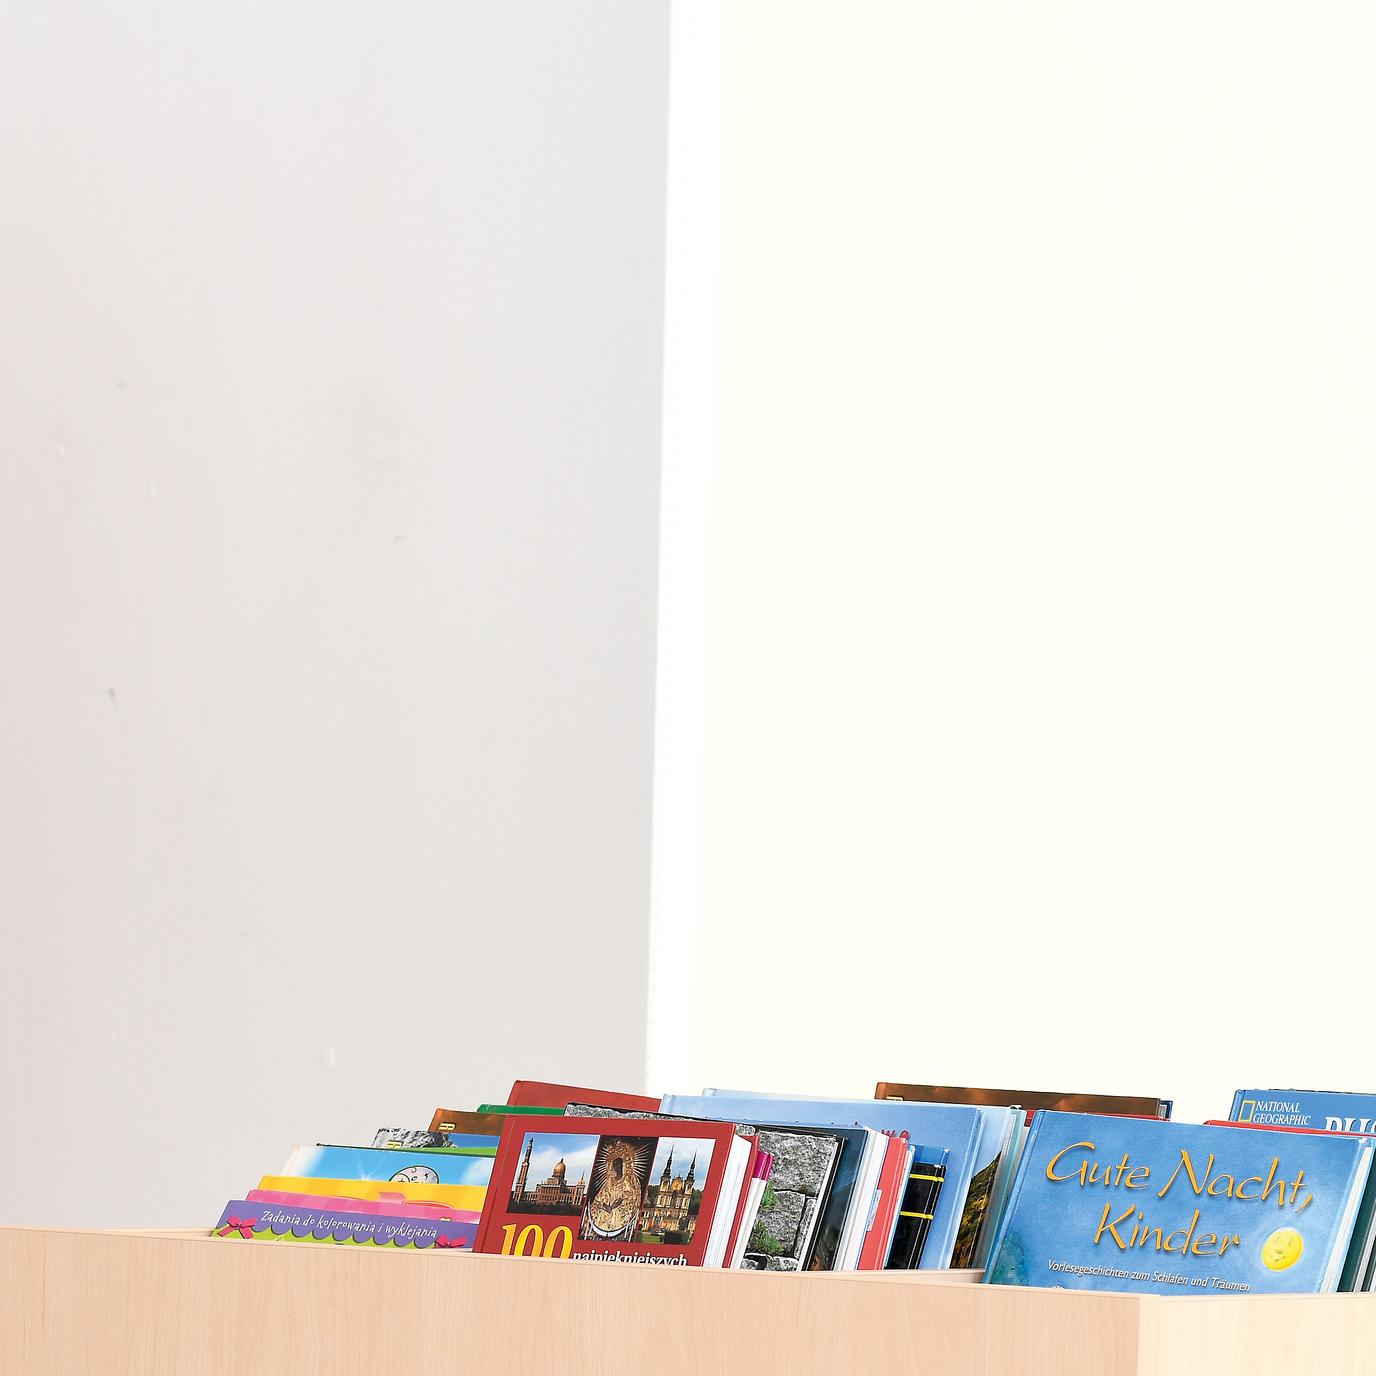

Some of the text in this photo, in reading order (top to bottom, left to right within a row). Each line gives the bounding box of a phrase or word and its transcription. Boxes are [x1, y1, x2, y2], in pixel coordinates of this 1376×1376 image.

[1252, 1112, 1311, 1126] GEOGRAPHIC
[1255, 1100, 1301, 1113] NATIONAL
[1045, 1141, 1314, 1214] Gute Nacht,
[261, 1210, 438, 1240] Zadania do kolorowania i wyklejania
[501, 1223, 574, 1260] 100
[1093, 1202, 1241, 1256] Kinder
[1048, 1259, 1251, 1293] Vorlesegeschichten zum Schlafen und Träumen
